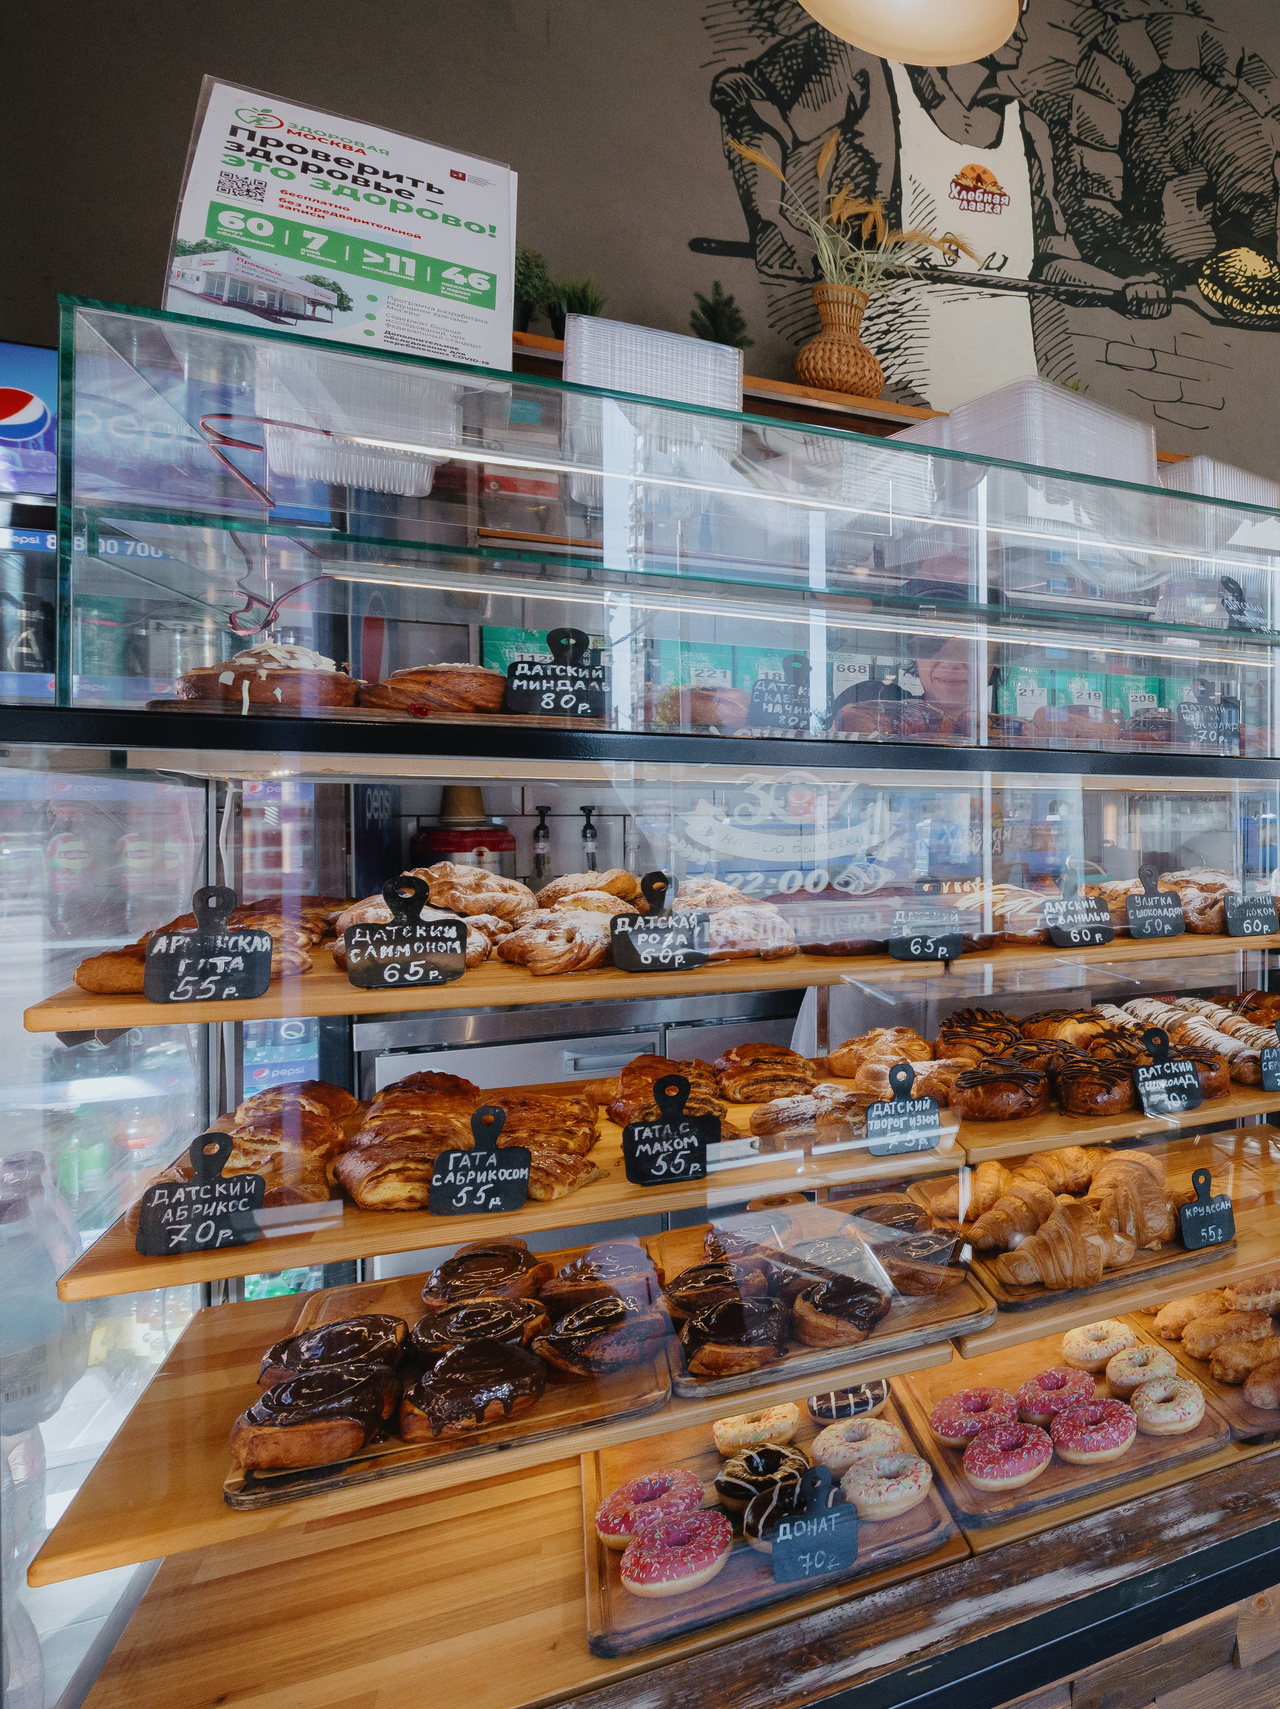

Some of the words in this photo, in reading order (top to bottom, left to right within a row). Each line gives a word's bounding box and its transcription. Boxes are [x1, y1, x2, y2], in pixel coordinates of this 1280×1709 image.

[287, 129, 367, 156] МОСКВА
[288, 122, 390, 156] ЗДОРОВАЯ
[224, 140, 416, 200] здоровье
[229, 125, 445, 195] Проверить
[280, 189, 351, 212] бесплатно
[950, 182, 1009, 205] Хлебная
[277, 204, 326, 219] записи
[309, 177, 497, 238] здорово!
[960, 200, 1001, 215] лавка
[218, 210, 274, 237] 60
[278, 198, 302, 208] без
[306, 205, 422, 239] предварительной
[302, 229, 329, 251] 7
[363, 248, 416, 277] >11
[441, 266, 491, 291] 46
[386, 305, 420, 317] Москвы
[386, 300, 431, 315] ведущими
[433, 312, 468, 324] врачами
[387, 295, 436, 311] Программа
[437, 307, 489, 325] разработана
[385, 312, 428, 327] Содержит
[430, 323, 462, 335] больше
[452, 354, 490, 365] COVID-19
[515, 661, 604, 679] ДАТСКИЙ
[694, 668, 728, 680] 221
[760, 671, 784, 682] 18
[836, 664, 868, 675] 668
[512, 678, 612, 693] МИНДАЛЬ
[1018, 687, 1046, 697] 217
[1076, 691, 1102, 701] 219
[1130, 694, 1156, 704] 208
[1043, 896, 1098, 914] ДАТСКИЙ
[1134, 895, 1173, 907] УЛИТКА
[614, 912, 698, 935] ДАТСКАЯ
[271, 1066, 305, 1078] pepsi
[1138, 1061, 1194, 1081] ДАТСКИЙ
[871, 1098, 931, 1117] ДАТСКИЙ
[633, 1123, 672, 1142] ГАТА
[679, 1122, 690, 1134] С
[635, 1136, 699, 1157] МАКОМ
[448, 1152, 497, 1171] ГАТА
[151, 1176, 256, 1207] ДАТСКИЙ
[161, 1198, 250, 1224] АБРИКОС
[1185, 1200, 1233, 1218] КРУАССАН
[776, 1512, 841, 1544] ДОНАТ
